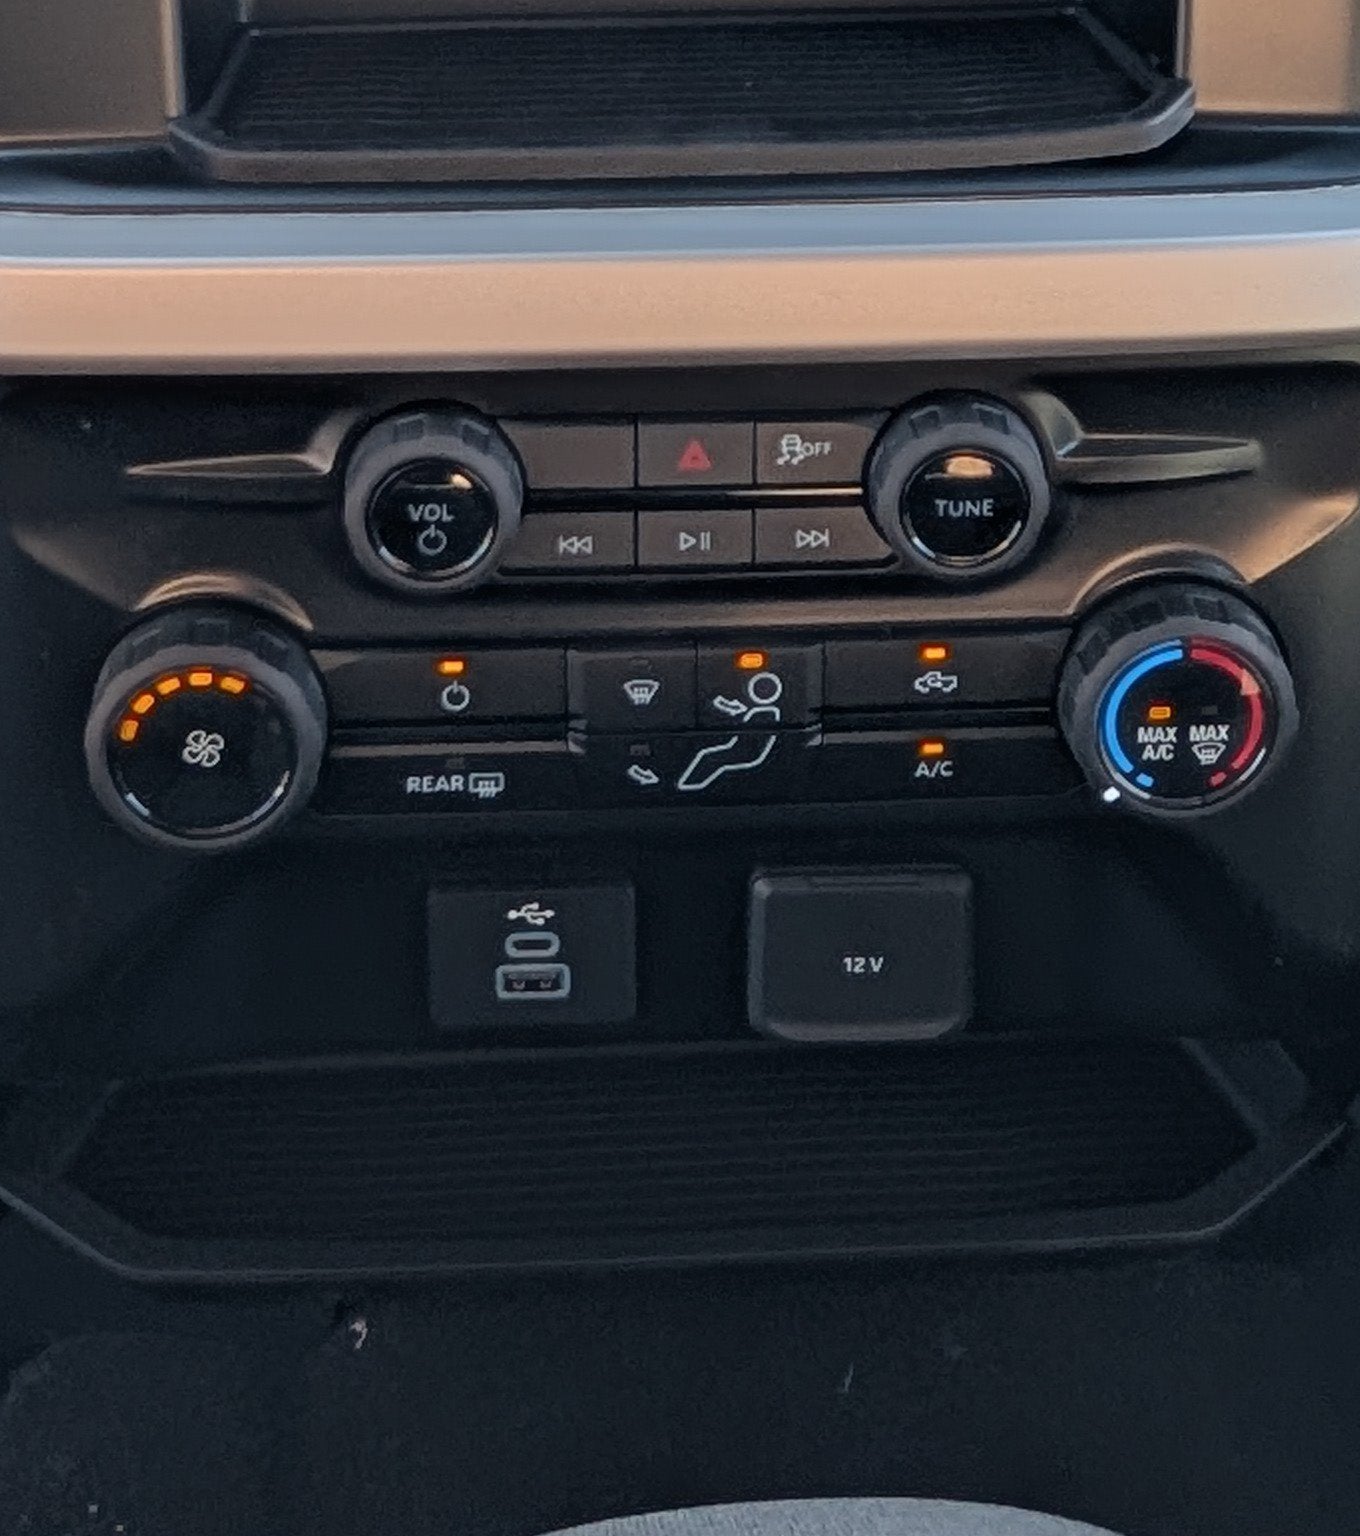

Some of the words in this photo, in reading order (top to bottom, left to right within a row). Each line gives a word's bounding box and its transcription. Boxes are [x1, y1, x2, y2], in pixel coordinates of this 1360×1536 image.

[803, 440, 832, 456] OFF
[408, 503, 453, 523] VOL
[935, 499, 994, 518] TUNE
[1139, 726, 1178, 744] MAX
[1189, 724, 1230, 742] MAX
[1142, 743, 1175, 762] A/C
[915, 760, 954, 778] A/C
[406, 773, 465, 794] REAR
[843, 957, 866, 974] 12
[867, 957, 885, 974] V
